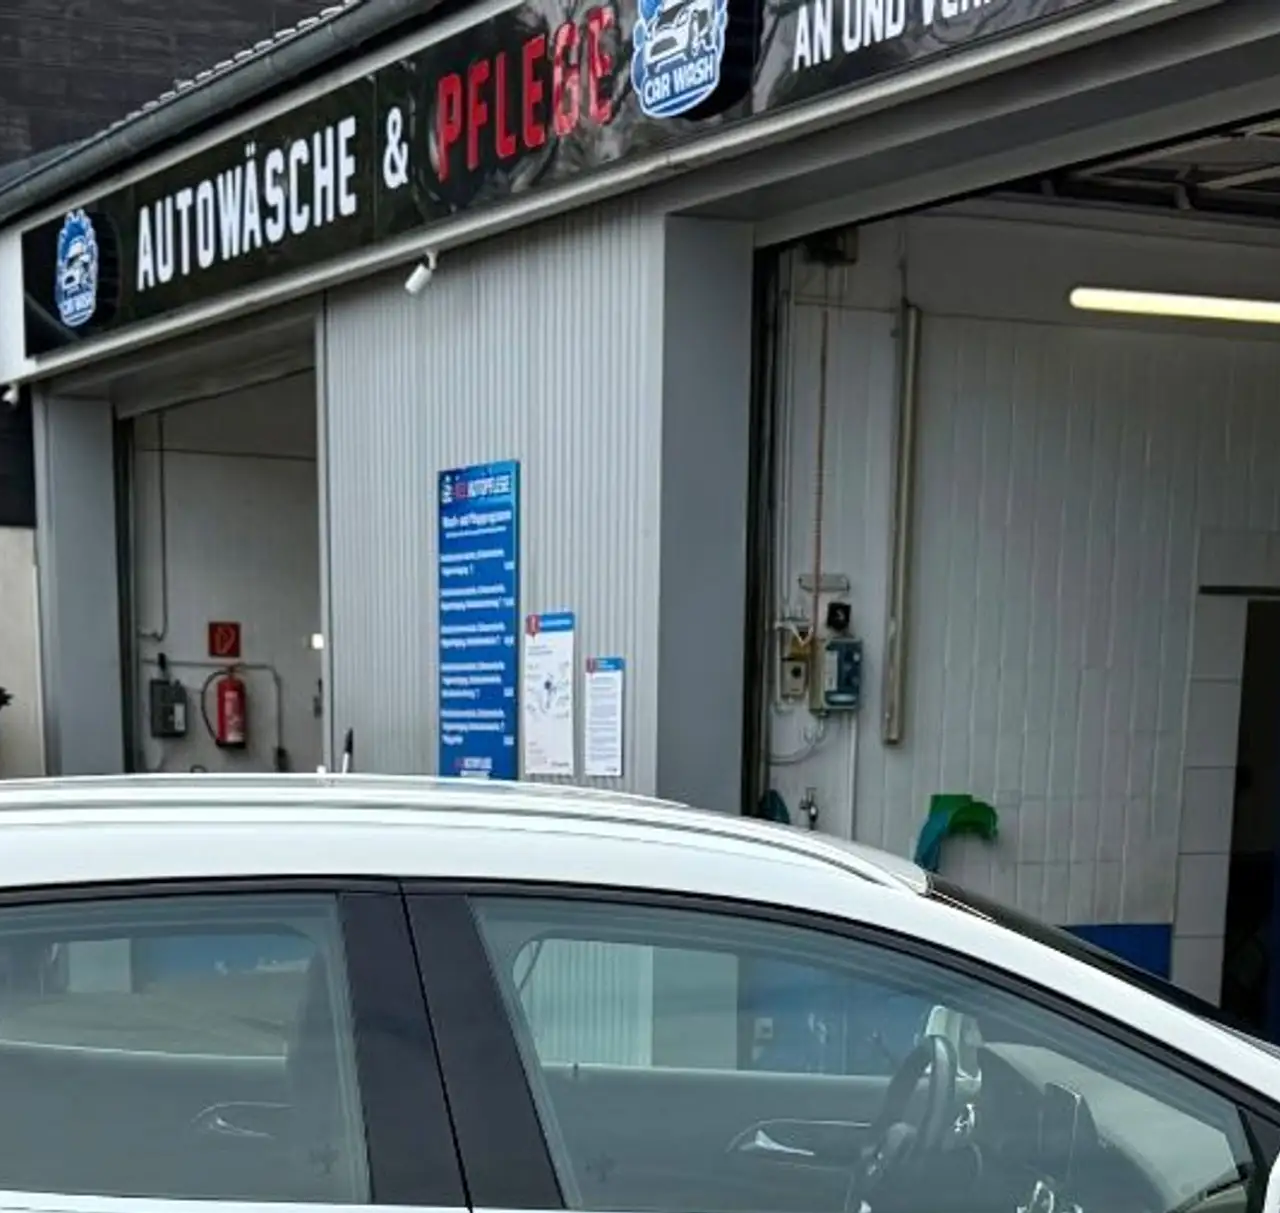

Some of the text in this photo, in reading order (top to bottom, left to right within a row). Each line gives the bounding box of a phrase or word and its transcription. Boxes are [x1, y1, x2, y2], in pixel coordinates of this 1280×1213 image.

[793, 0, 832, 72] AN
[644, 55, 714, 105] CAR WASH
[136, 6, 615, 292] AUTOWÄSCHE & PFLEGE
